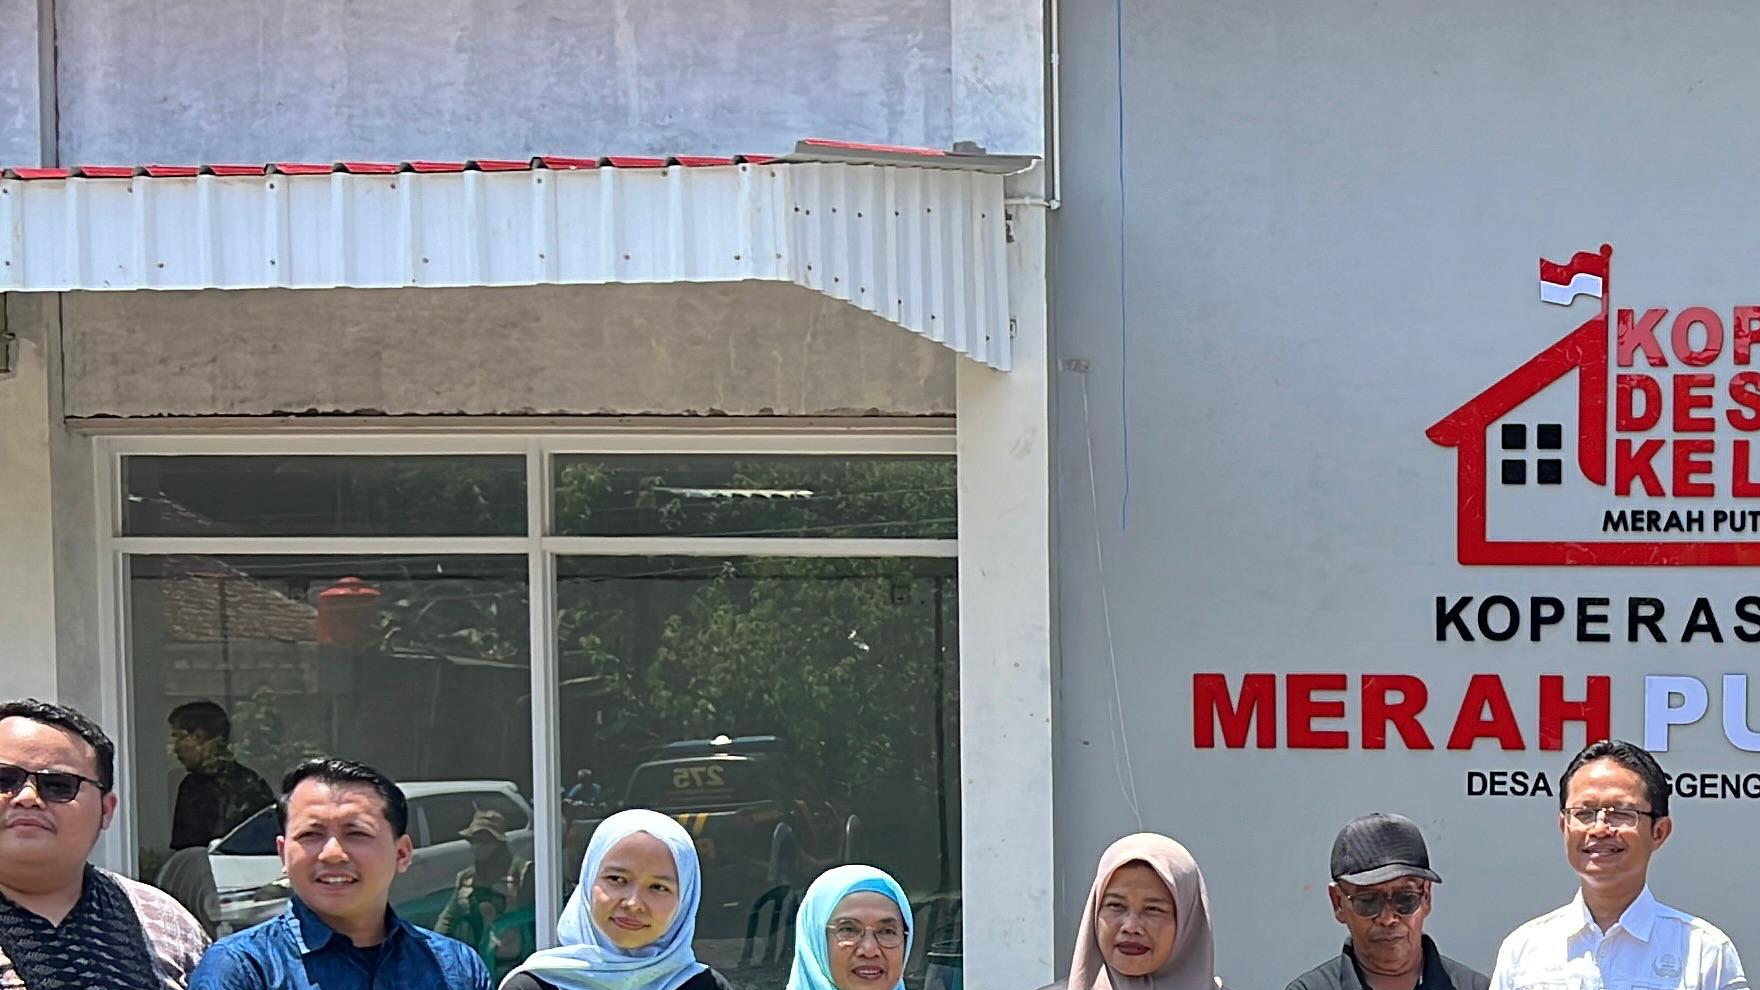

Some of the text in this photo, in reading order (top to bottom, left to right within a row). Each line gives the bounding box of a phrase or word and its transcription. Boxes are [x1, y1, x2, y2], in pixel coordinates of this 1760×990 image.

[1602, 509, 1704, 532] MERAH
[1193, 673, 1611, 750] MERAH
[1467, 771, 1553, 797] DESA
